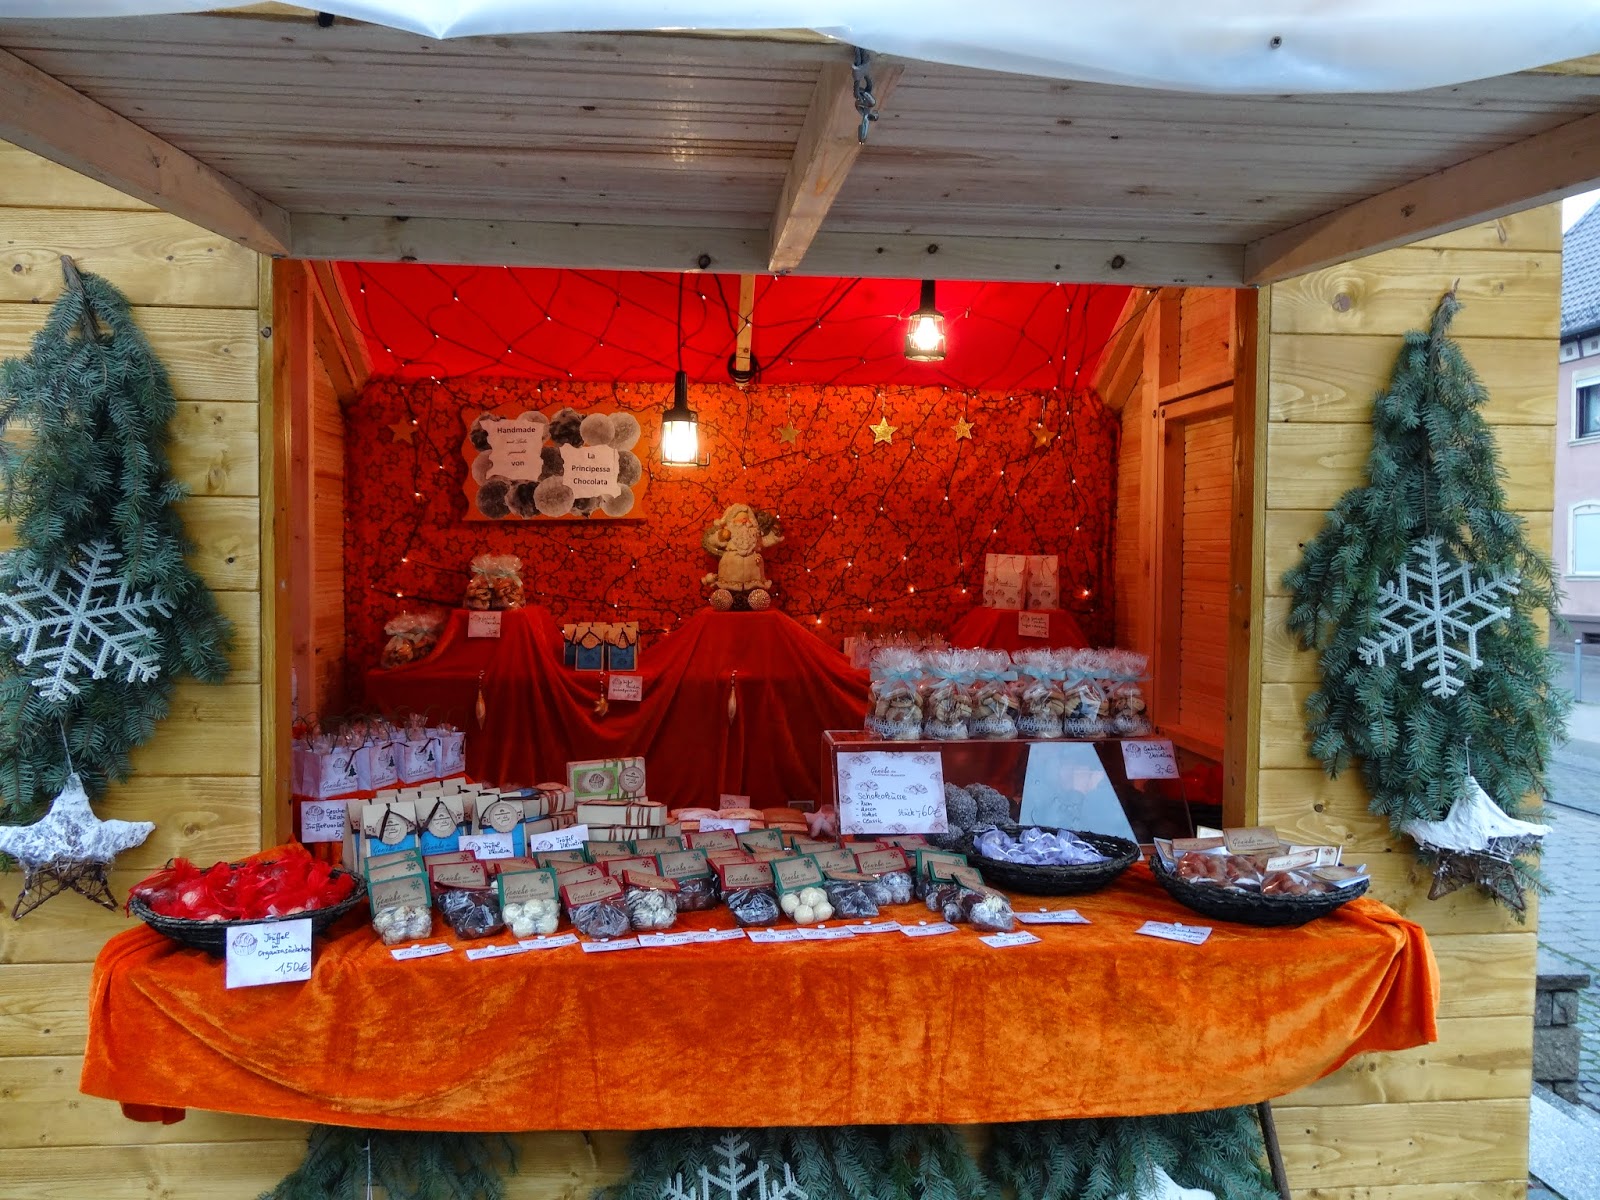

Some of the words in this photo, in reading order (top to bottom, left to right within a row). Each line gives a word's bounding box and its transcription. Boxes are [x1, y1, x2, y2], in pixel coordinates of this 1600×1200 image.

[497, 426, 536, 434] Handmade
[587, 452, 596, 460] La
[571, 465, 611, 474] Principessa
[573, 477, 608, 486] Chocolata
[275, 961, 310, 975] 1,50€
